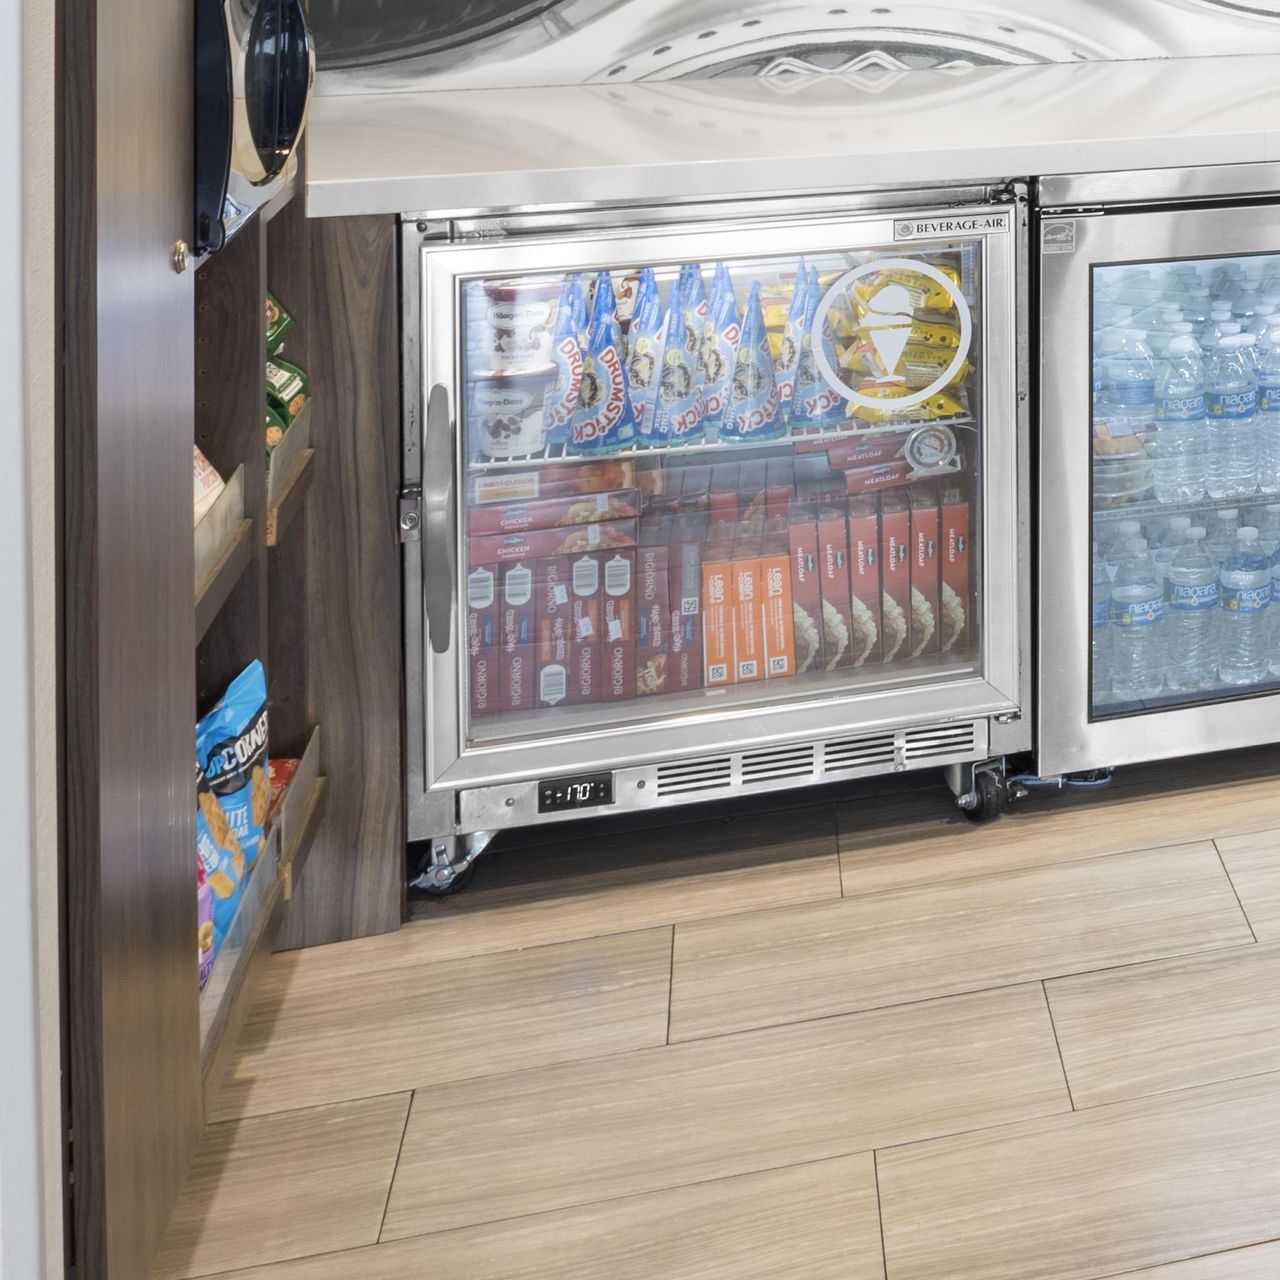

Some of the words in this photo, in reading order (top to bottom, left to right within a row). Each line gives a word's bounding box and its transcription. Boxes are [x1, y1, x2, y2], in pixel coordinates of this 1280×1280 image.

[917, 219, 1003, 233] BEVERAGE-AIR
[847, 450, 883, 461] MEATLOAF
[864, 473, 900, 485] MEATLOAF
[500, 517, 533, 526] CHICKEN
[497, 545, 530, 555] CHICKEN
[889, 536, 897, 572] MEATLOAF
[948, 528, 956, 563] MEATLOAF
[797, 547, 805, 583] MEATLOAF
[826, 544, 834, 580] MEATLOAF
[857, 540, 865, 576] MEATLOAF
